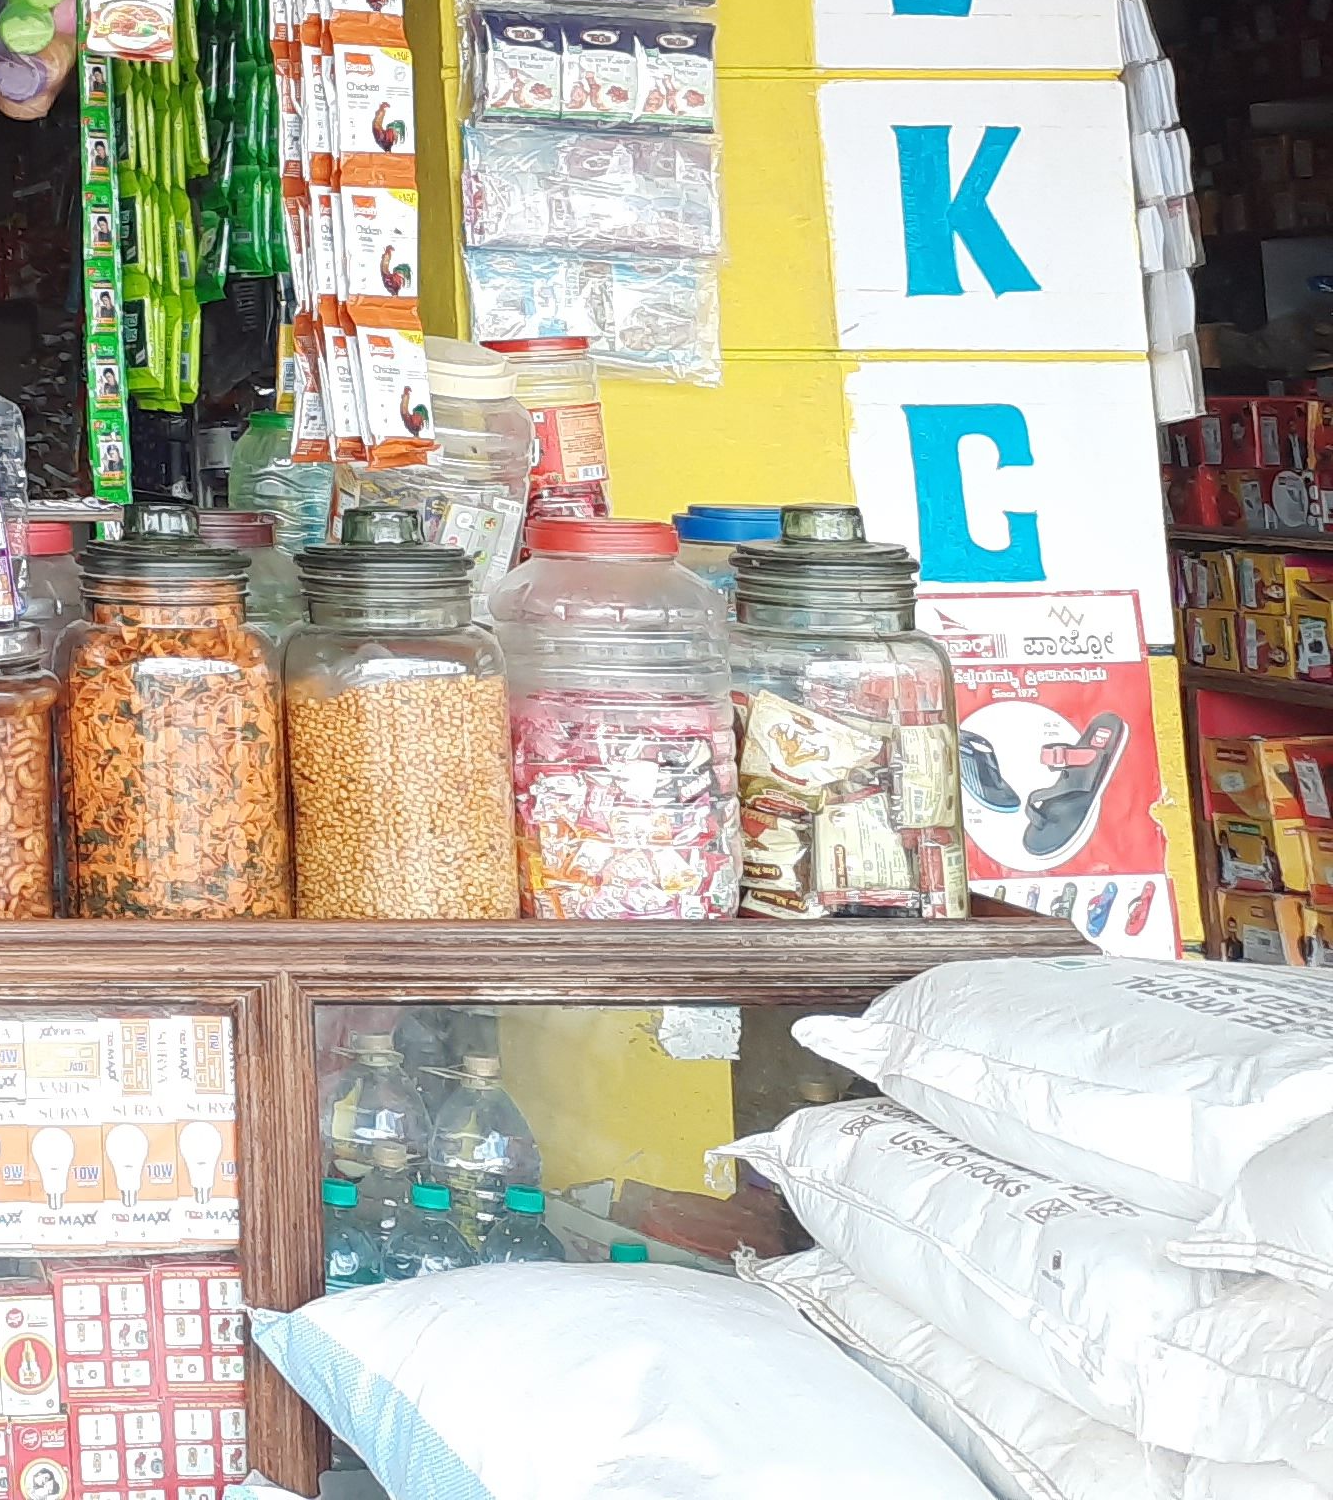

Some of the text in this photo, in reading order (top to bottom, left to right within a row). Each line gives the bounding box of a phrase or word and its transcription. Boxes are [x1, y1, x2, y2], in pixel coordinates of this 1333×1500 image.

[889, 1129, 931, 1159] USE
[4, 1165, 23, 1179] 9W
[72, 1165, 99, 1180] 10W
[147, 1163, 173, 1178] 10W
